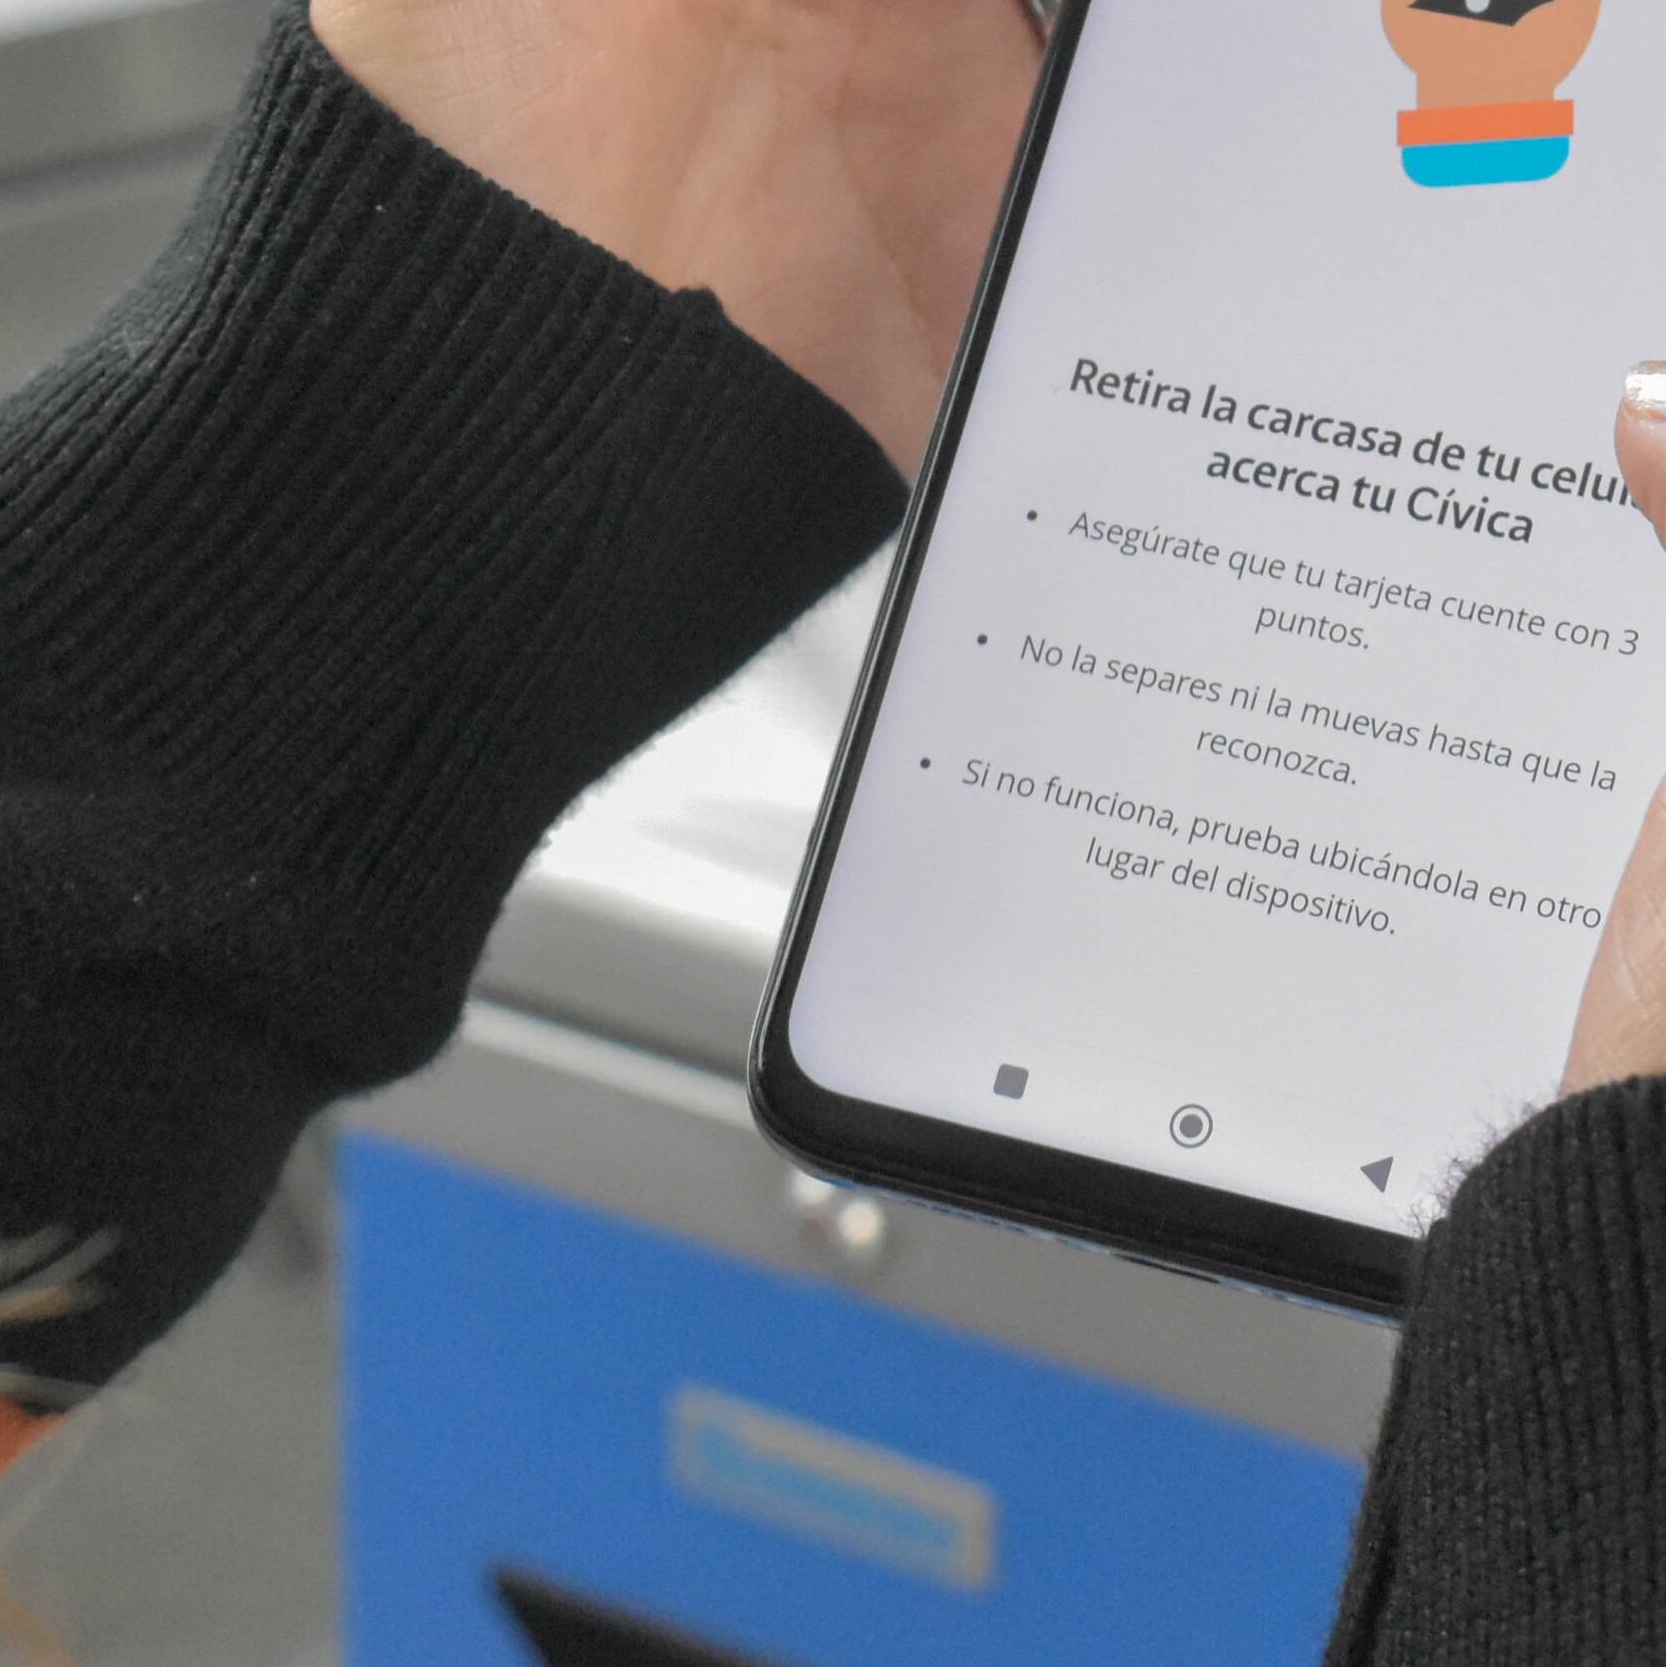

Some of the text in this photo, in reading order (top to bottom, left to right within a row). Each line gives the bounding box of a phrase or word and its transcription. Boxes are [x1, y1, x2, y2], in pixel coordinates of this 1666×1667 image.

[1069, 357, 1638, 509] Retira la carcasa de tu celul
[1205, 451, 1534, 545] acerca tu Cívica
[1067, 511, 1639, 656] Asegúrate que tu tarjeta cuente con 3
[1254, 606, 1369, 650] puntos.
[1020, 634, 1617, 792] No la separes ni la muevas hasta que la
[1196, 730, 1357, 786] reconozca.
[961, 758, 1602, 929] Si no funciona, prueba ubicándola en otro
[1085, 835, 1395, 935] lugar del dispositivo.
